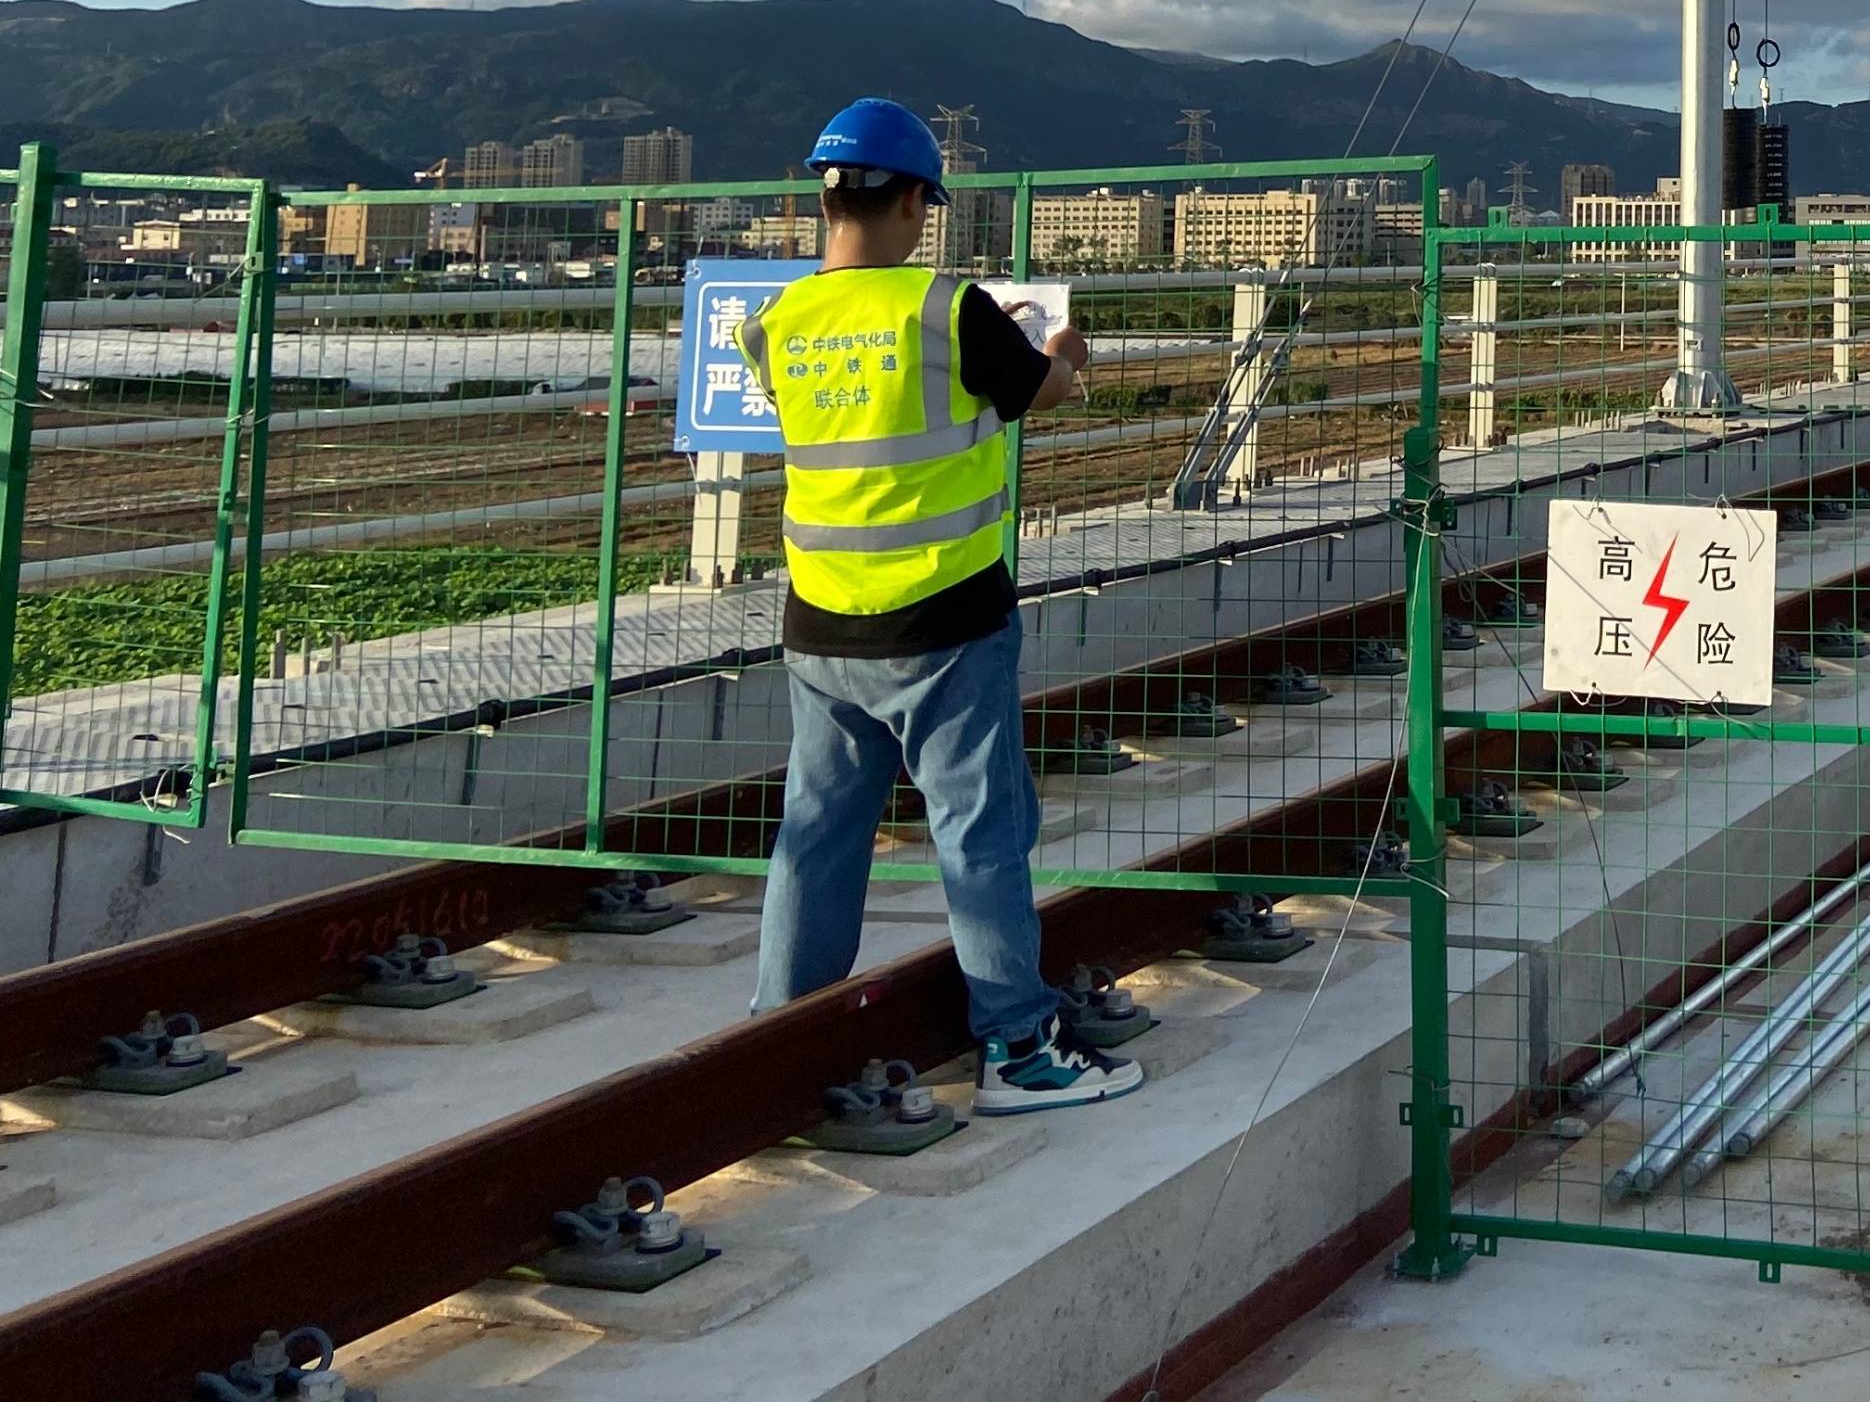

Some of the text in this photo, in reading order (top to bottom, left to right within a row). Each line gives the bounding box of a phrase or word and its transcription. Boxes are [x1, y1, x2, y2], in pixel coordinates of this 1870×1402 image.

[813, 331, 896, 353] 中铁电气化局
[814, 385, 870, 409] 联合体
